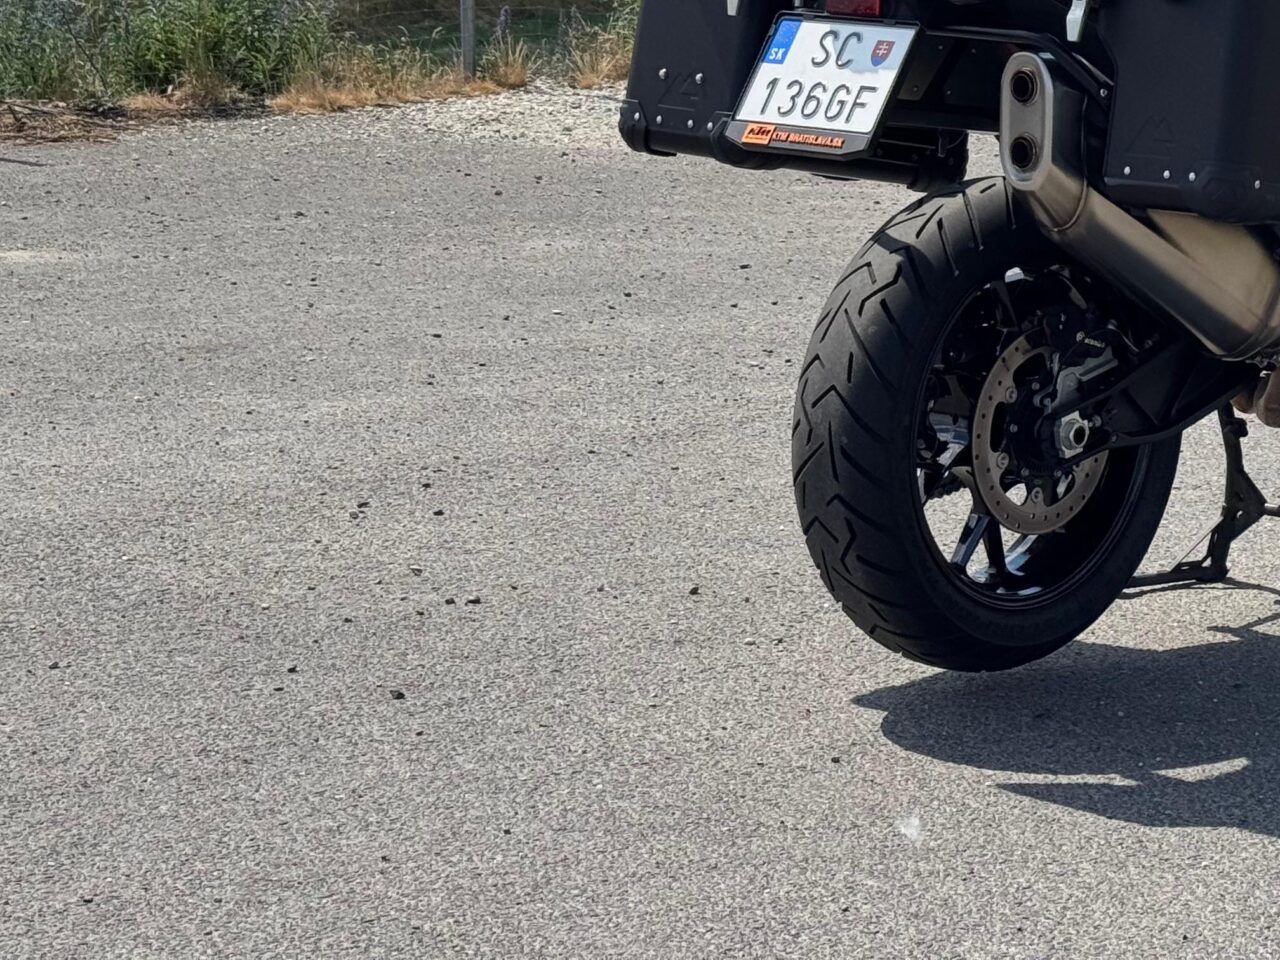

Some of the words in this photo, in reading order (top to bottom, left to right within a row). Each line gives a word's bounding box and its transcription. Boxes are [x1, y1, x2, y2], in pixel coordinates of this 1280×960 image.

[768, 48, 785, 60] SK
[811, 29, 864, 69] SC
[760, 77, 880, 124] 136GF
[747, 126, 771, 136] KTM
[772, 131, 788, 141] KTM
